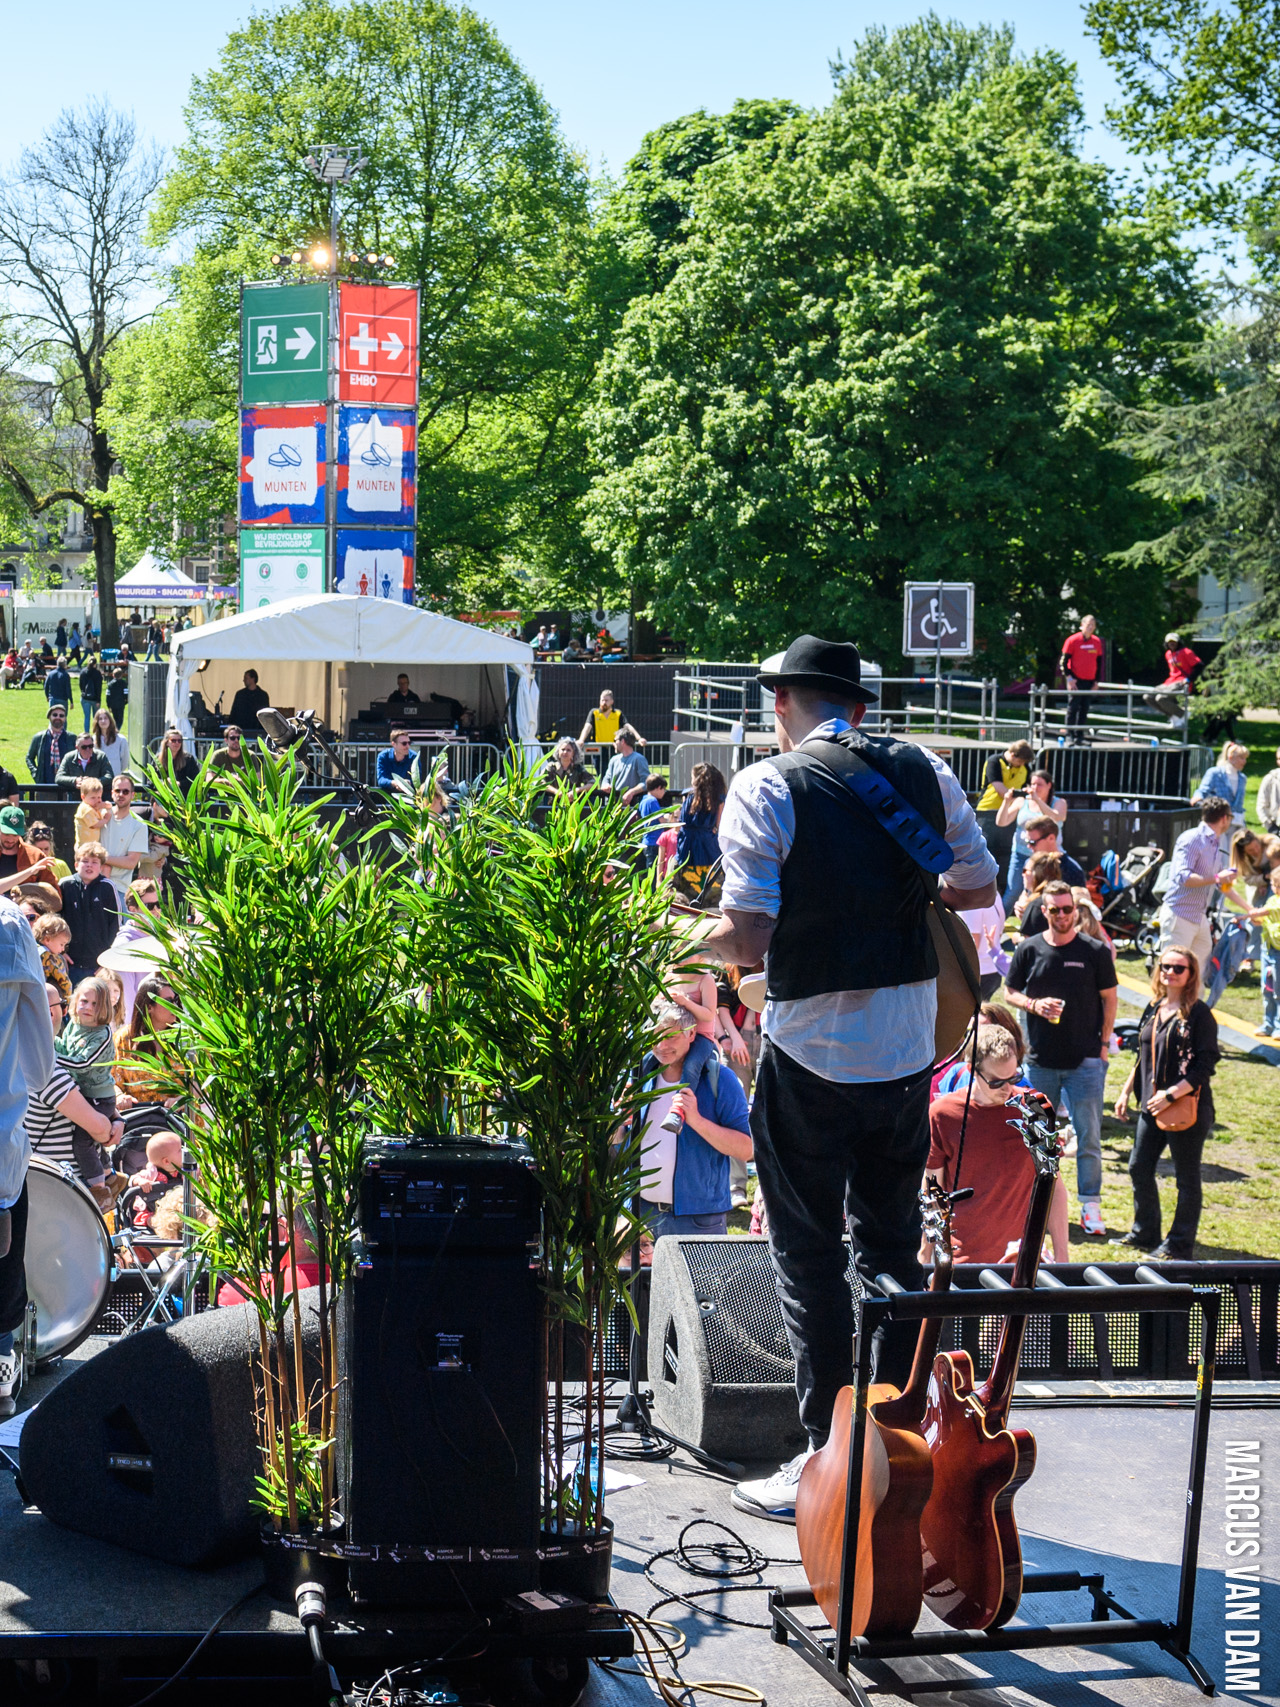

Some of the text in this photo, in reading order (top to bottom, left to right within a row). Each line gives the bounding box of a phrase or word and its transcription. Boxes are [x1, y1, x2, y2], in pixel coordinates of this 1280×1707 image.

[349, 374, 377, 387] EHBO
[264, 481, 307, 492] MUNTEN
[356, 480, 396, 491] MUNTEN
[162, 588, 194, 596] SNACKS
